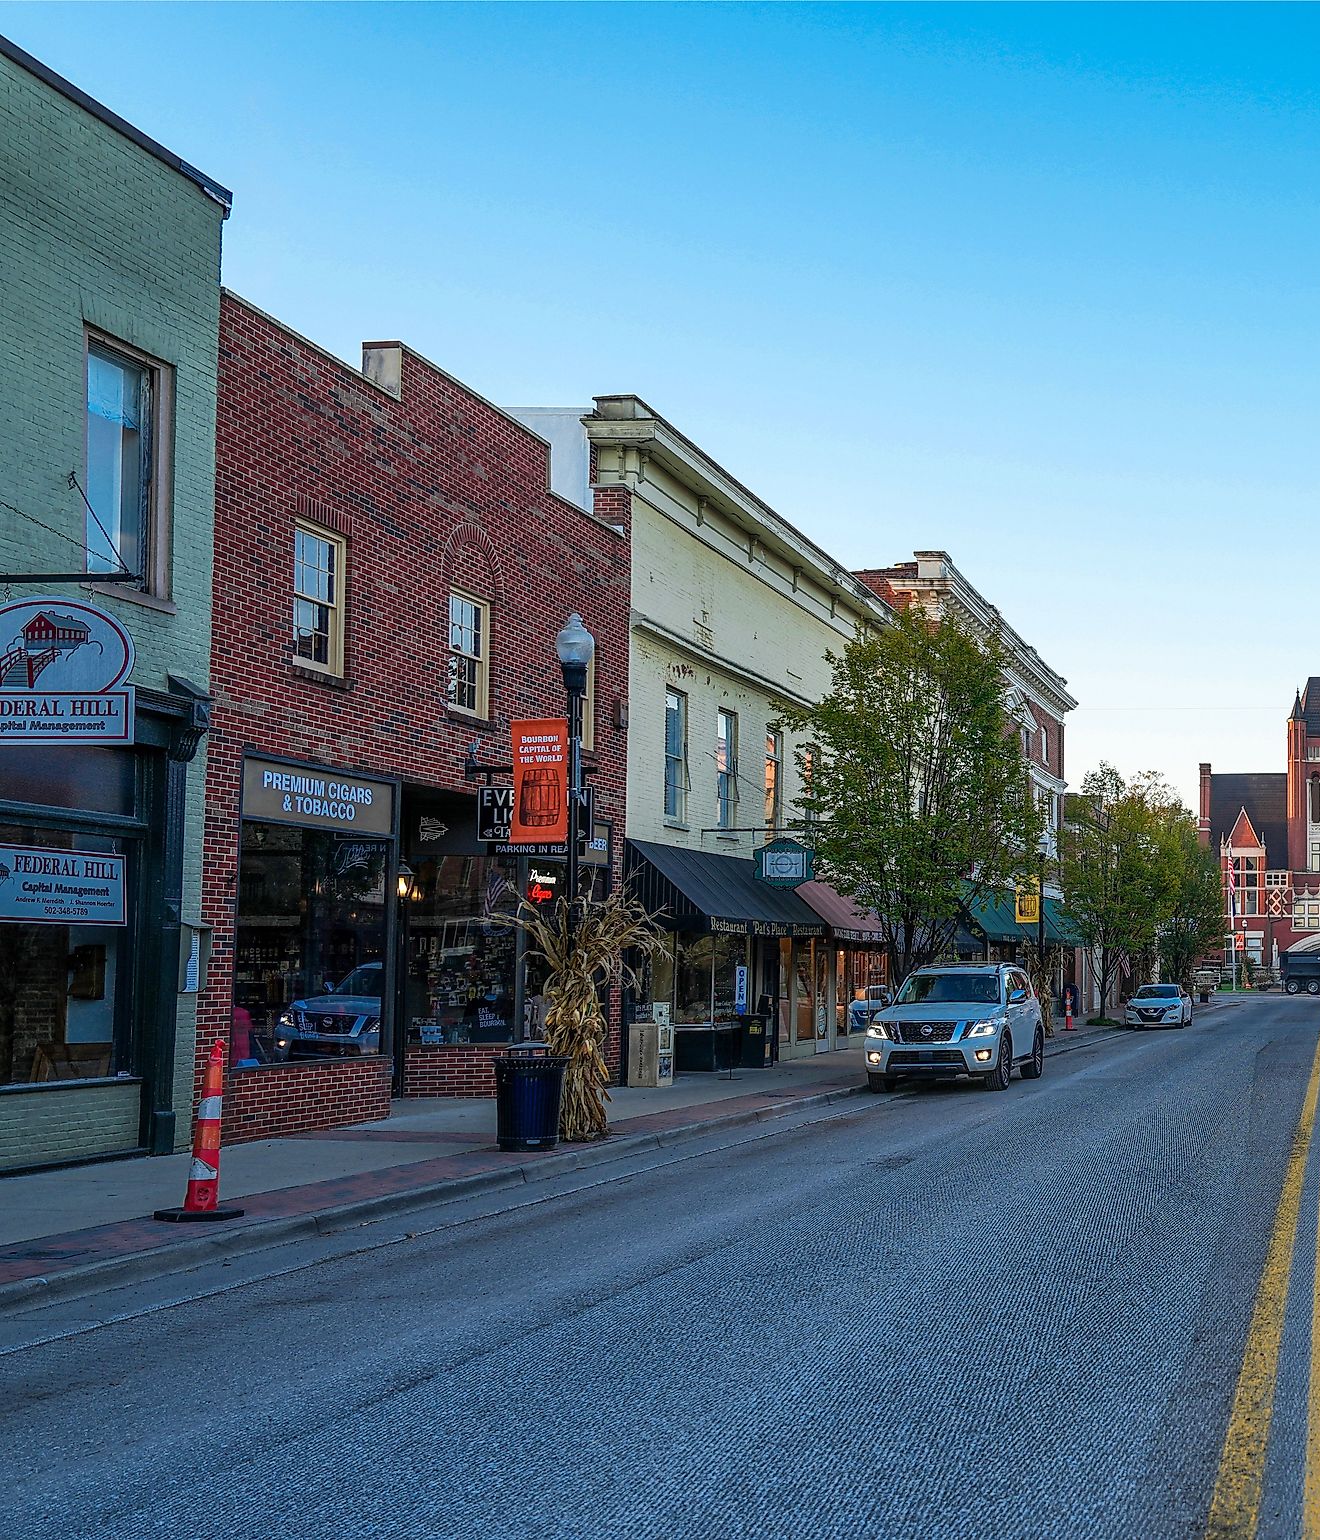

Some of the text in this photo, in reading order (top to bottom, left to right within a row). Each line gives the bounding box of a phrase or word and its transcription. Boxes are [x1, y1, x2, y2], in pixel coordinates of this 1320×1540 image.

[0, 698, 119, 717] DERAL HILL
[29, 720, 106, 733] Management
[263, 770, 373, 806] PREMIUM CIGARS
[283, 794, 356, 821] & TOBACCO
[495, 844, 568, 854] PARKING IN REA
[13, 854, 119, 880] FEDERAL HILL
[22, 881, 110, 898] Capital Management
[710, 916, 748, 933] Restaurant
[792, 923, 823, 936] Restaurant
